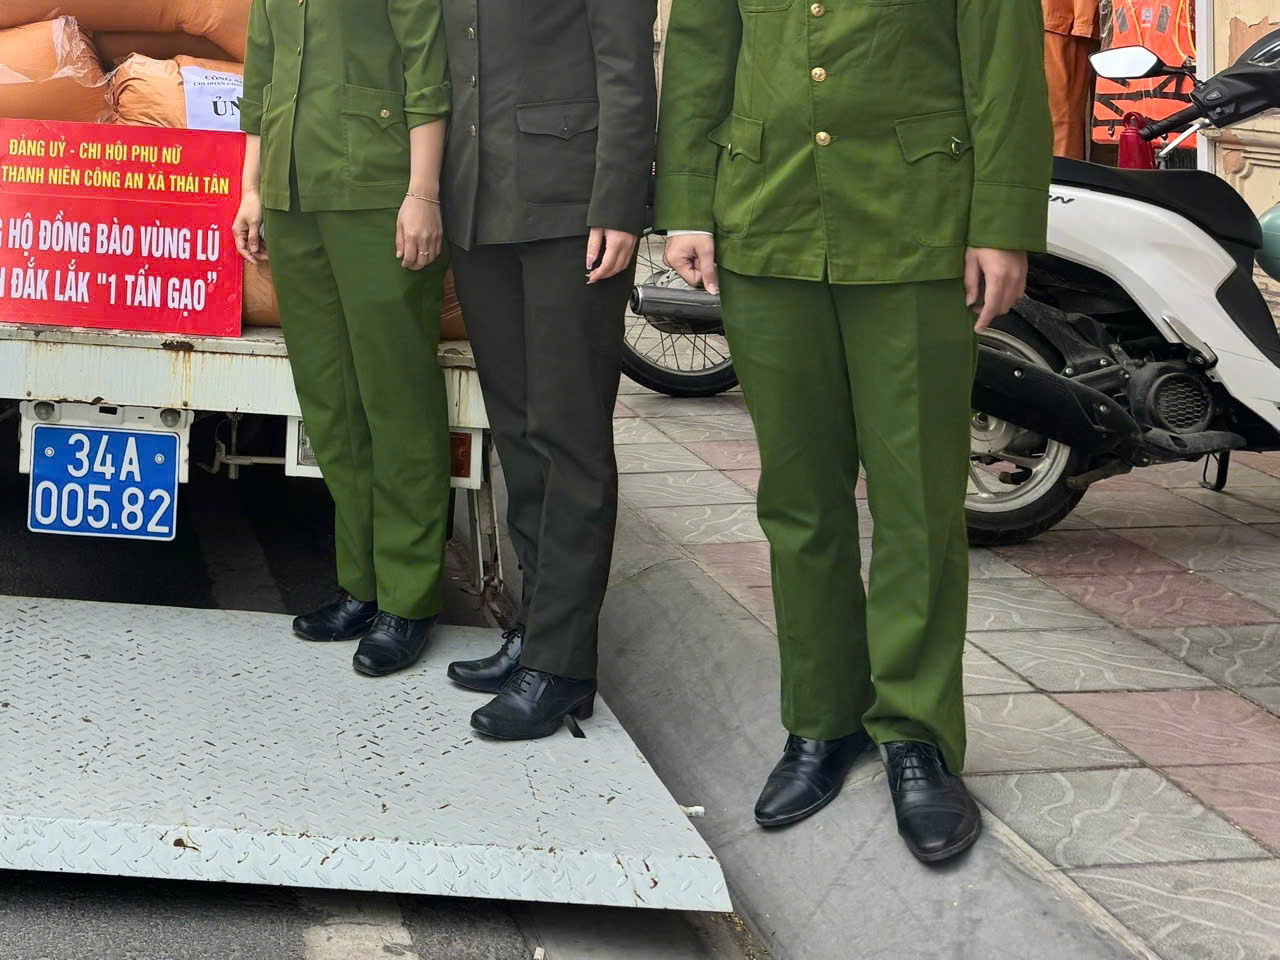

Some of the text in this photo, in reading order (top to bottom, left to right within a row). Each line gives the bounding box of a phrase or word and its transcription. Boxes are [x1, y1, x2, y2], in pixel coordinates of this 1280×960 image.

[9, 134, 45, 158] ĐẢNG
[49, 136, 66, 158] UỶ
[79, 142, 102, 161] CHI
[105, 141, 128, 165] HỘI
[131, 144, 158, 167] PHỤ
[161, 143, 183, 165] NỮ
[1, 165, 45, 184] THANH
[48, 164, 81, 186] NIÊN
[84, 167, 121, 189] CÔNG
[124, 171, 143, 190] AN
[147, 169, 166, 192] XÃ
[169, 171, 200, 194] THÁI
[202, 173, 230, 196] TÂN
[8, 212, 34, 257] HỘ
[38, 210, 91, 254] ĐỒNG
[95, 217, 134, 257] BÀO
[140, 219, 191, 260] VÙNG
[196, 224, 221, 262] LŨ
[10, 256, 50, 301] ĐẮK
[54, 259, 90, 304] LẮK
[124, 265, 162, 309] TẤN
[67, 432, 142, 483] 34A
[34, 480, 171, 534] 005.82
